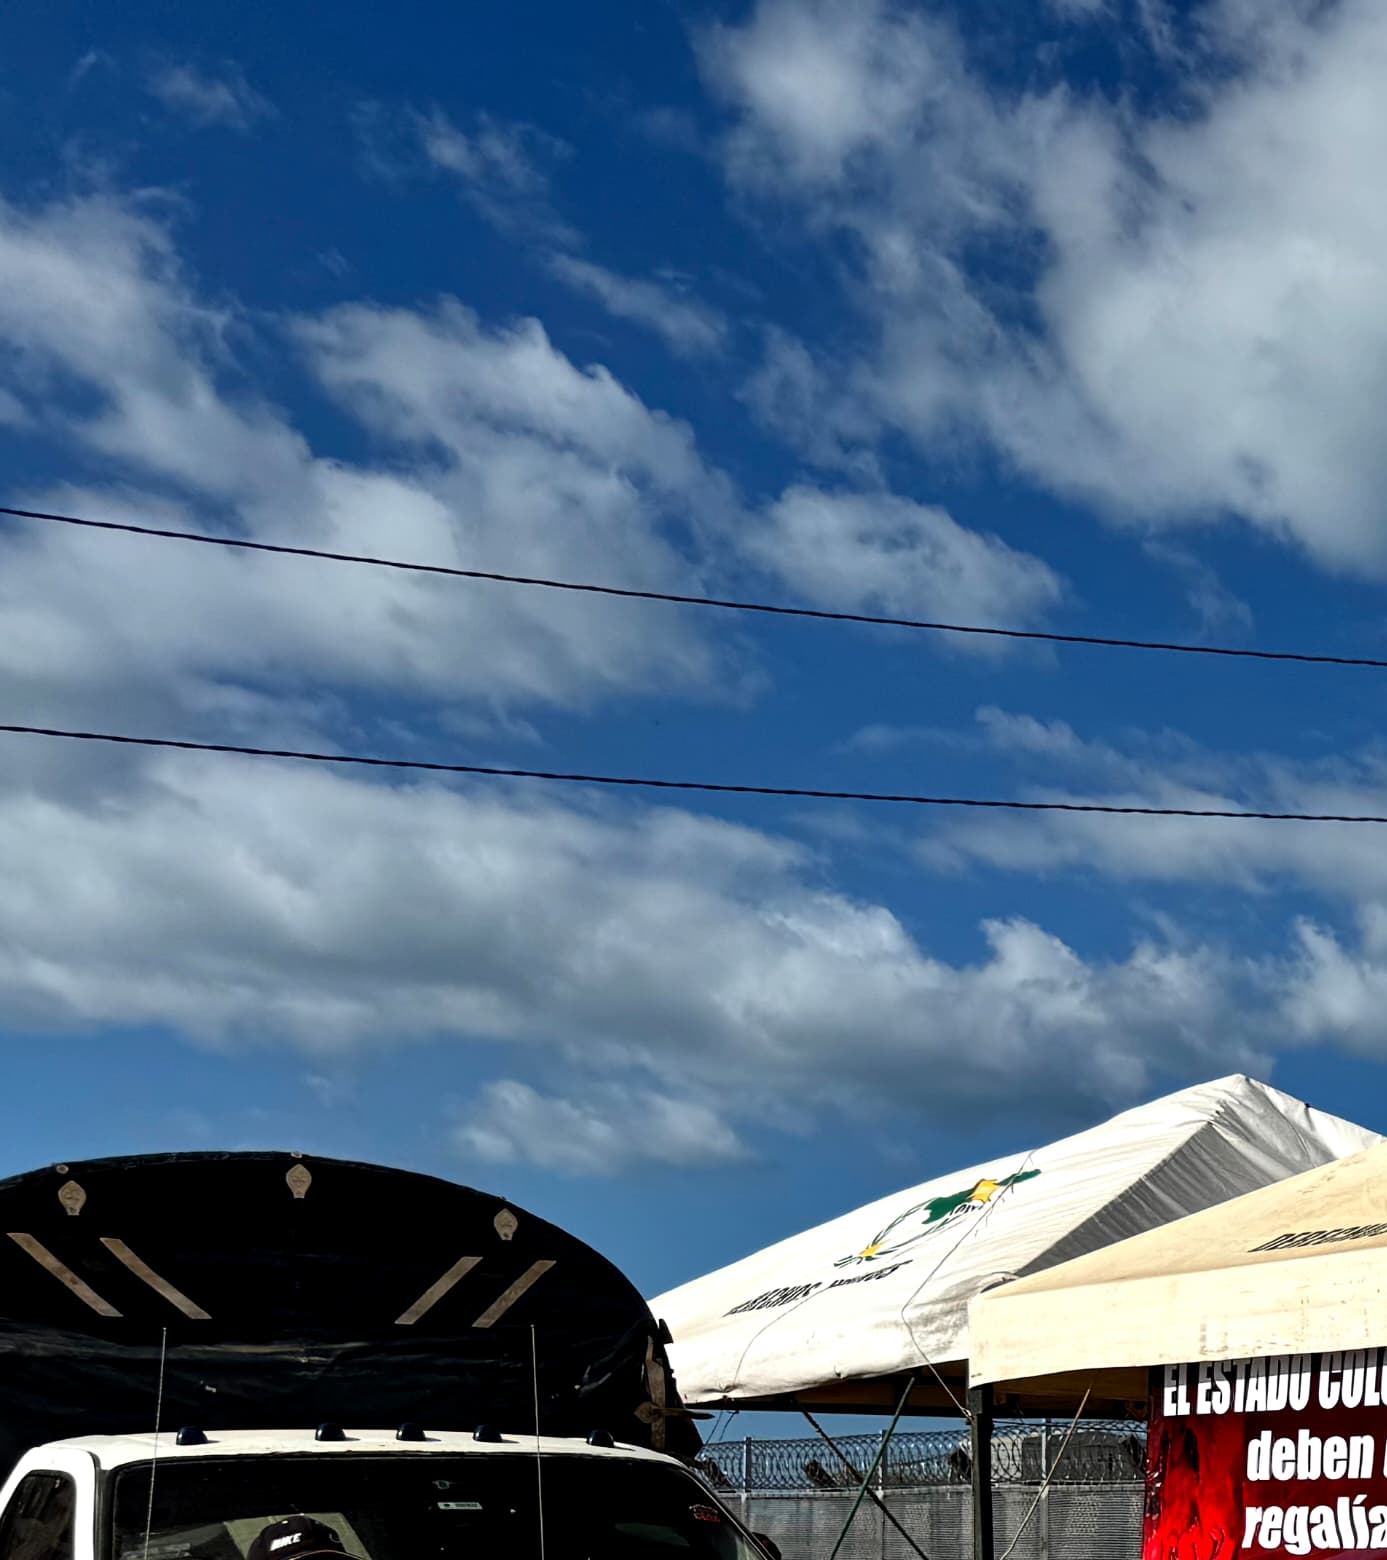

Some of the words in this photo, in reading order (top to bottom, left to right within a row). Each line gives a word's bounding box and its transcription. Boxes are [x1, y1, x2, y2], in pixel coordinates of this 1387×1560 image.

[1163, 1363, 1191, 1416] EL
[1196, 1352, 1312, 1415] ESTADO
[1246, 1429, 1376, 1481] deben
